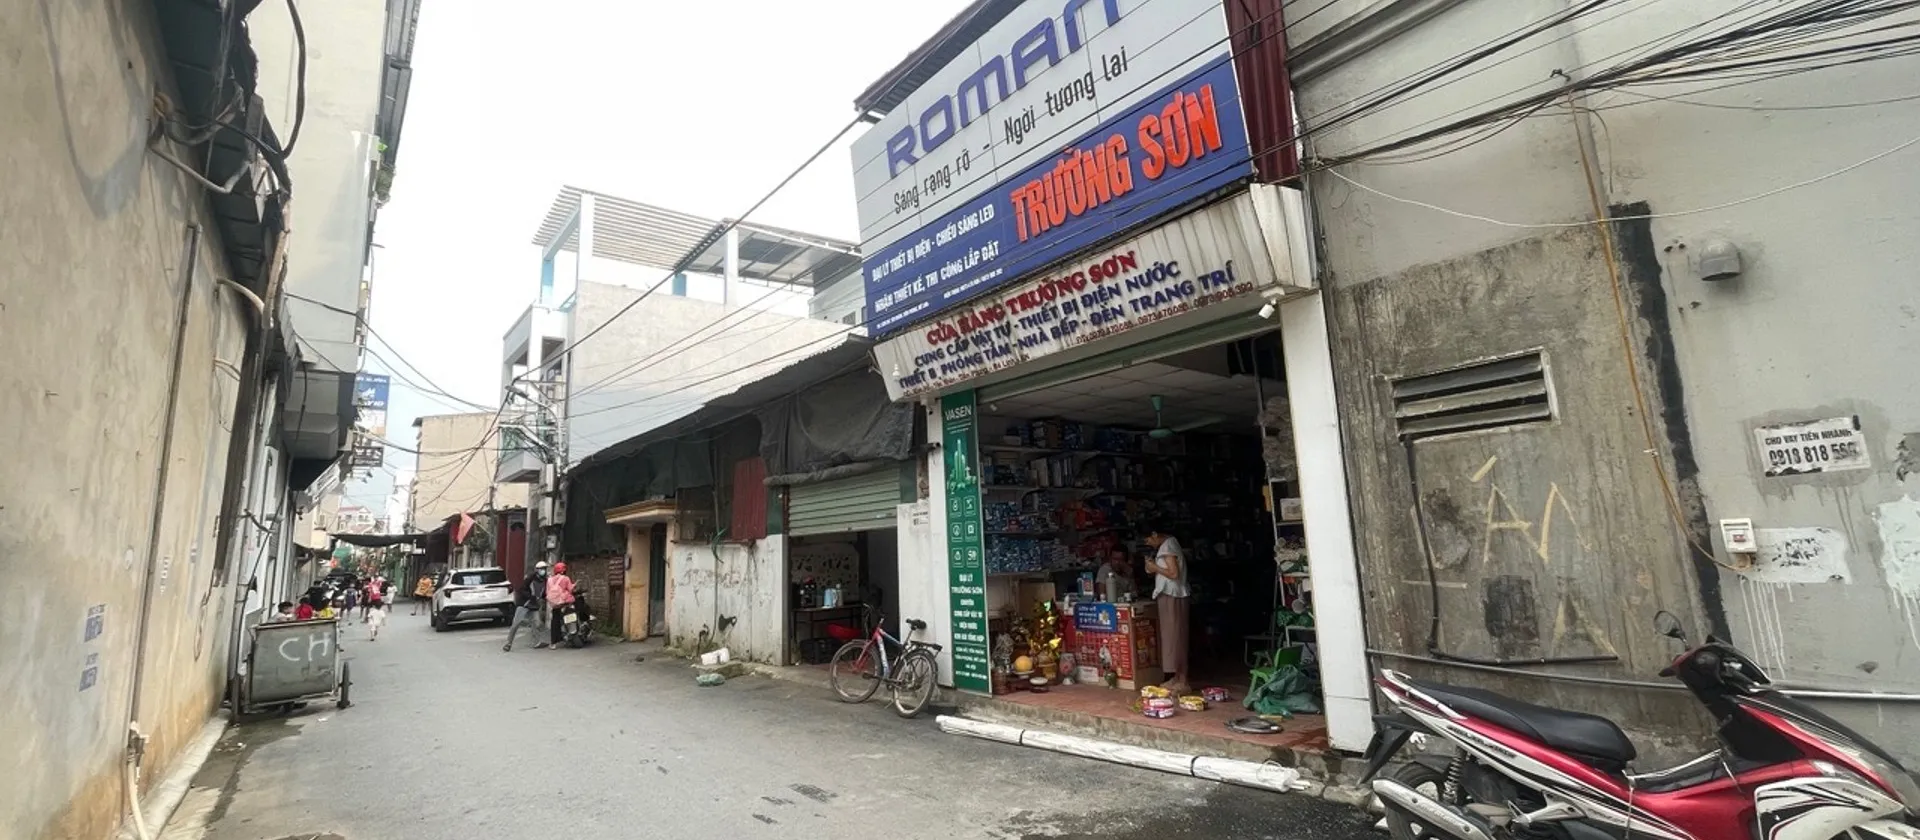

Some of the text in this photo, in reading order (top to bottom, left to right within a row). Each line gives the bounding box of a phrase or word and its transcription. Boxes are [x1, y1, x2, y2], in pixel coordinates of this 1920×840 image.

[893, 184, 920, 214] Sáng
[923, 164, 951, 197] rạng
[1004, 107, 1036, 145] Ngời
[1044, 70, 1096, 117] tương
[1101, 45, 1129, 81] lai
[1010, 84, 1223, 242] TRƯỜNG SƠN
[957, 211, 979, 236] SÁNG
[979, 203, 995, 224] LED
[940, 259, 963, 280] CÔNG
[981, 240, 999, 261] ĐẶT
[914, 349, 946, 368] CUNG
[946, 331, 970, 355] CẤP
[1019, 301, 1059, 330] THIẾT
[1060, 297, 1080, 316] BỊ
[1125, 260, 1181, 293] NƯỚC
[926, 320, 957, 346] CỬA
[1088, 250, 1138, 285] SƠN
[941, 348, 983, 375] PHÒNG
[1017, 327, 1049, 350] NHÀ
[1050, 316, 1079, 341] BẾP
[1090, 303, 1125, 327] ĐÈN
[1128, 280, 1195, 315] TRANG
[1198, 260, 1236, 292] TRÍ
[944, 404, 972, 421] VASEN
[1765, 436, 1782, 445] CHO
[1782, 435, 1798, 444] VAY
[1803, 444, 1829, 463] 818
